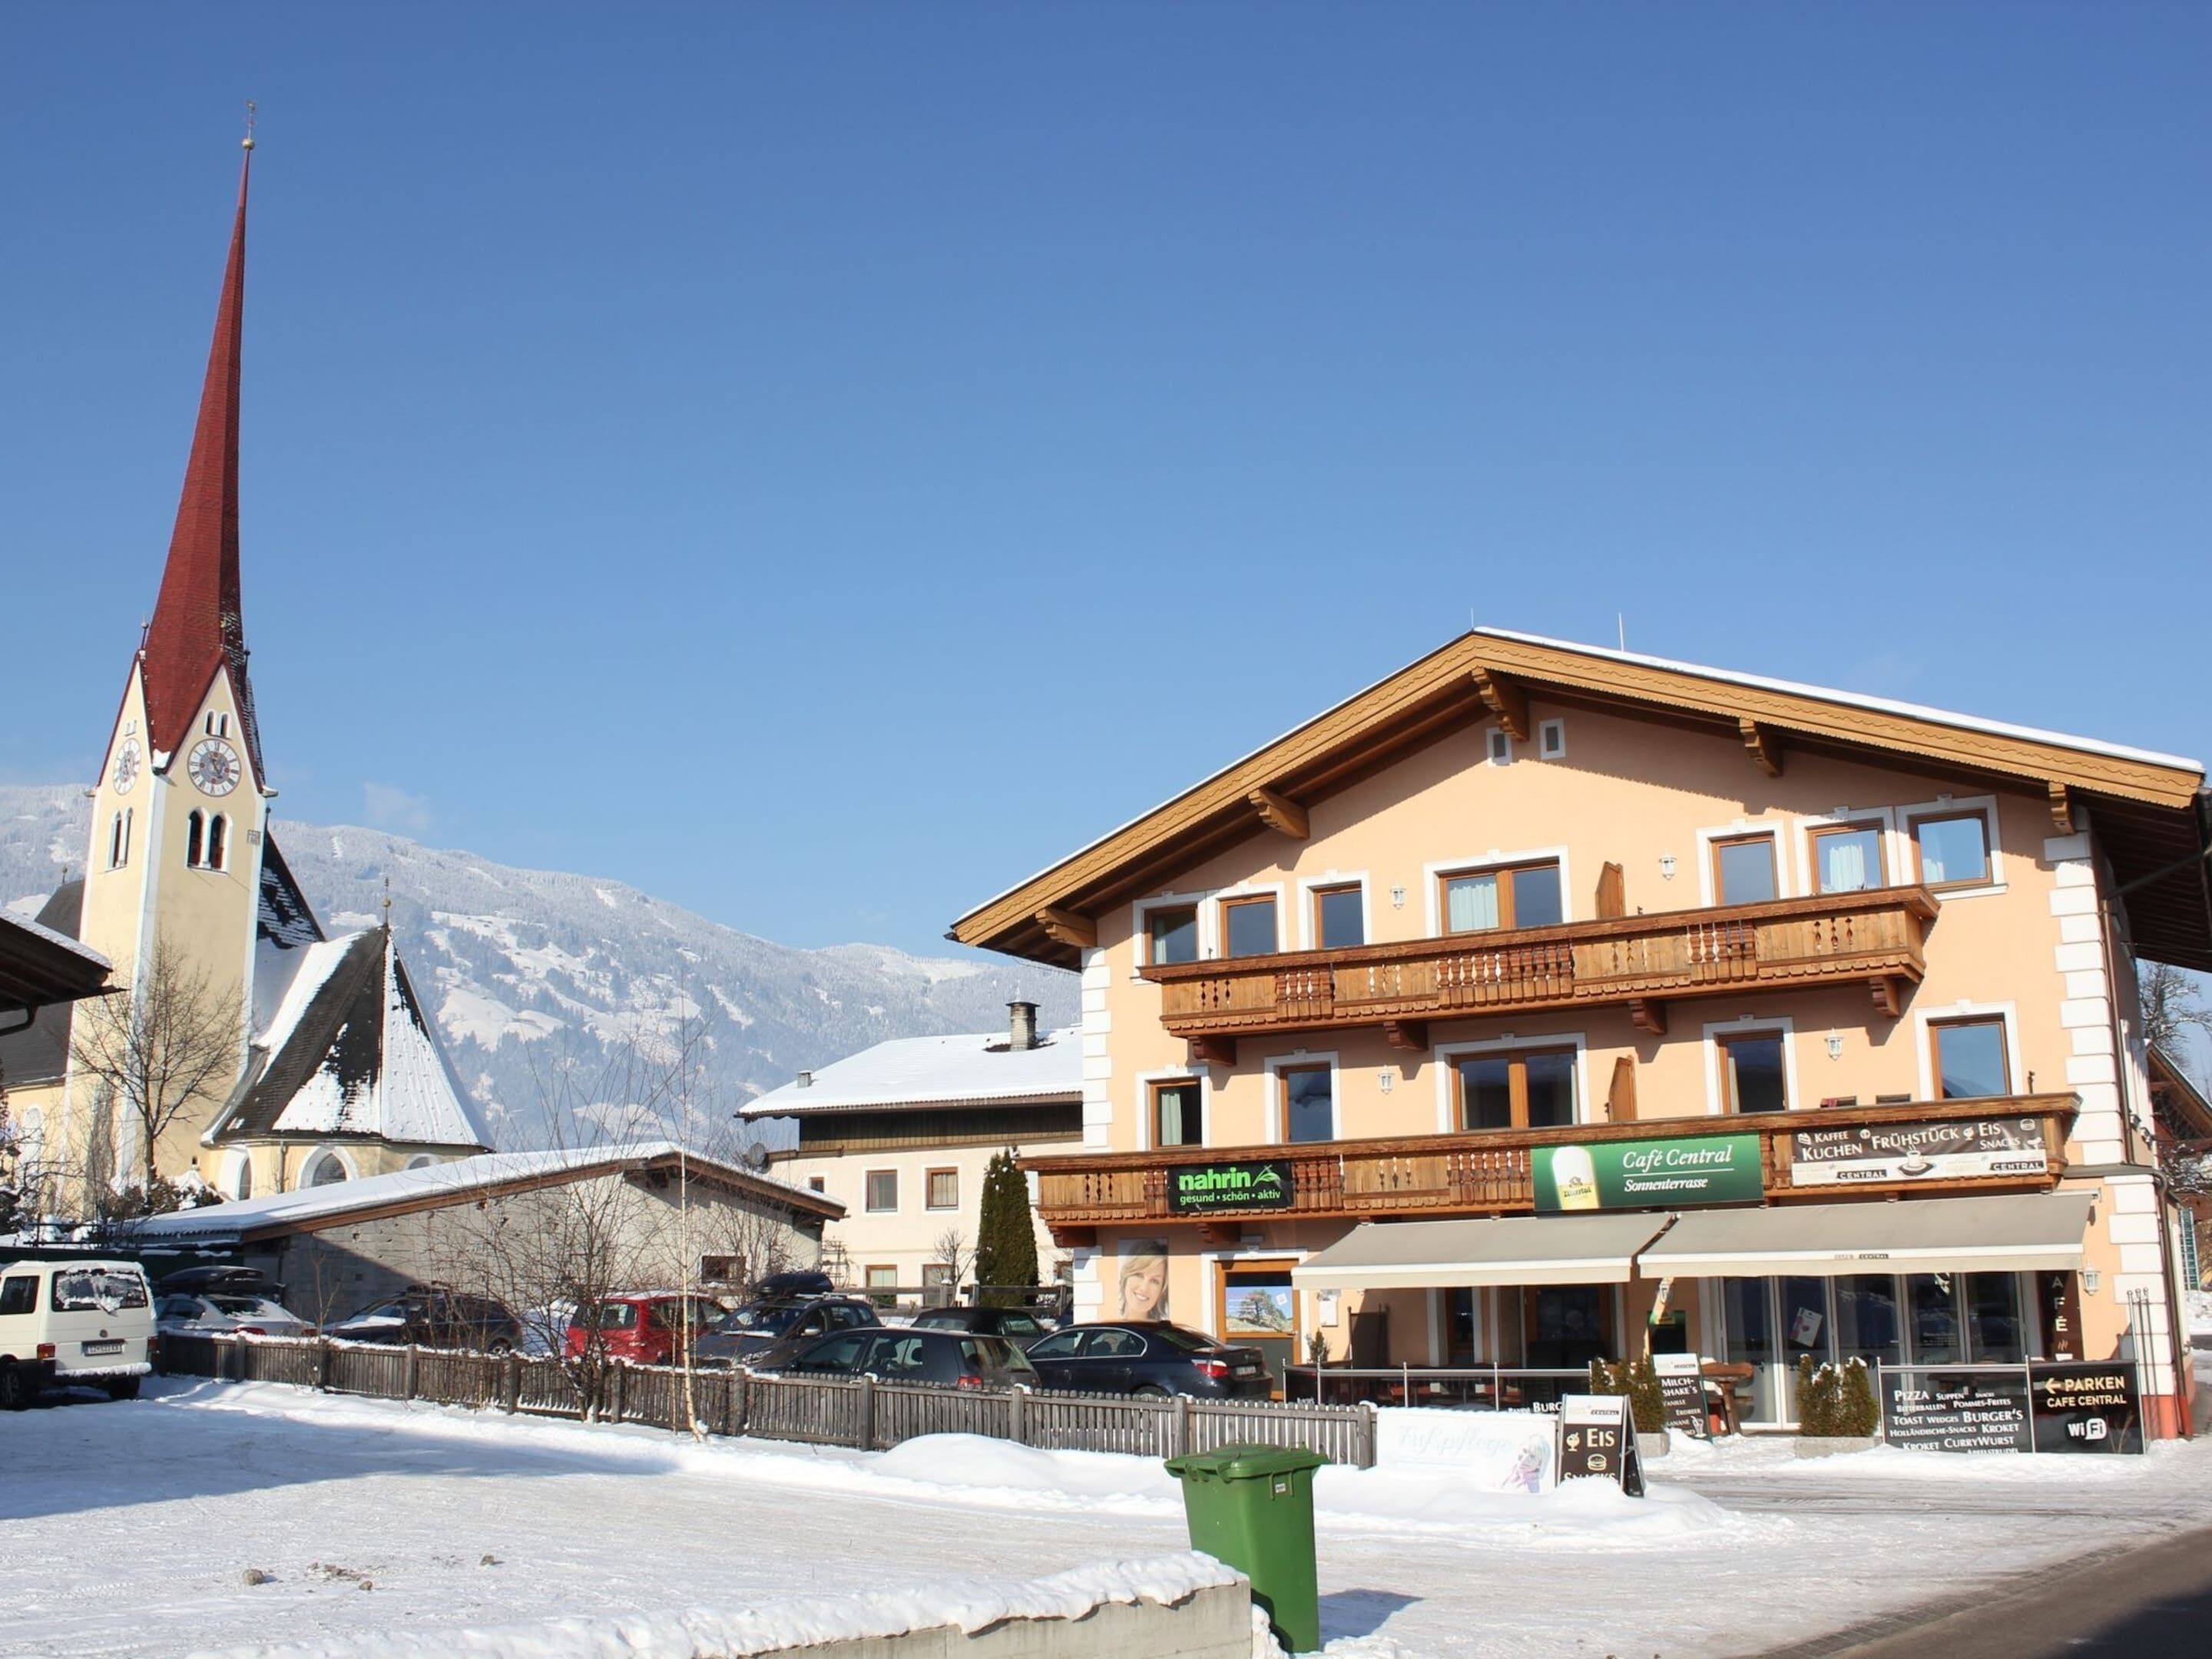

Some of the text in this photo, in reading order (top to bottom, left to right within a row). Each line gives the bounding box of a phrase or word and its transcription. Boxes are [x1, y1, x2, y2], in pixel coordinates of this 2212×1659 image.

[1978, 1122, 2002, 1137] EIS
[1815, 1131, 1849, 1143] KAFFEE
[1872, 1127, 1959, 1150] FRÜHSTÜCK
[1623, 1144, 1734, 1173] Café Central
[1802, 1142, 1863, 1161] KUCHEN
[1993, 1161, 2041, 1171] CENTRAL
[1179, 1167, 1251, 1190] nahrin
[1839, 1170, 1886, 1180] CENTRAL
[1624, 1178, 1709, 1193] Sonnenterrasse
[1180, 1189, 1281, 1206] gesund schön aktiv
[1661, 1378, 1694, 1388] MILCH-
[2064, 1376, 2126, 1392] PARKEN
[1894, 1389, 1929, 1402] PIZZA
[2046, 1394, 2128, 1408] CAFE CENTRAL
[1953, 1398, 2012, 1409] POMMES-FRITES
[1892, 1416, 1923, 1426] TOAST
[1982, 1423, 2020, 1434] KROKET
[1586, 1428, 1615, 1447] EIS
[1902, 1441, 1940, 1451] KROKET
